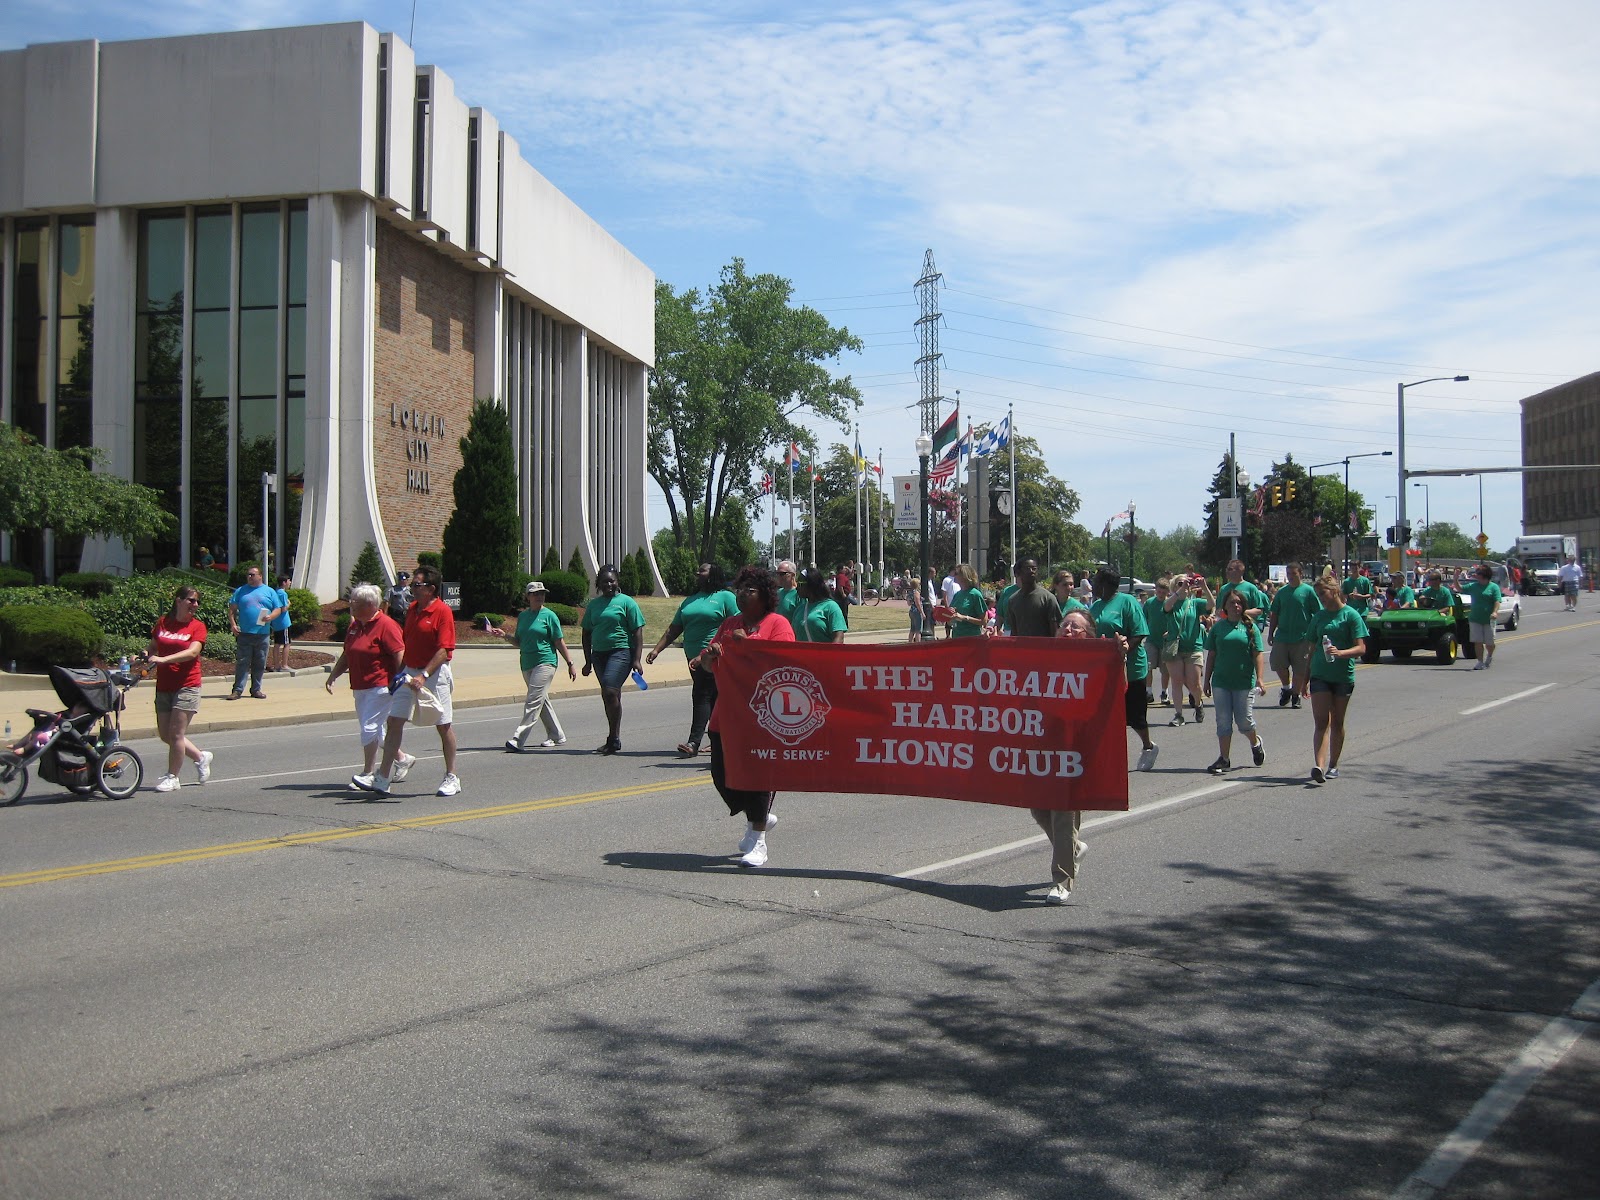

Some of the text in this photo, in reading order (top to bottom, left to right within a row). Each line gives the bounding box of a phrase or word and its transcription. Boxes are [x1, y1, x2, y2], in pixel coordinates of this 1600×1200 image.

[391, 403, 445, 439] LORAIN
[407, 468, 431, 494] HALL
[447, 586, 461, 596] POLICE
[767, 671, 811, 686] LIONS
[845, 665, 1089, 700] THE LORAIN
[780, 690, 803, 716] L
[765, 718, 816, 735] INTERNATIONAL
[891, 702, 1045, 737] HARBOR
[855, 737, 1085, 778] LIONS CLUB
